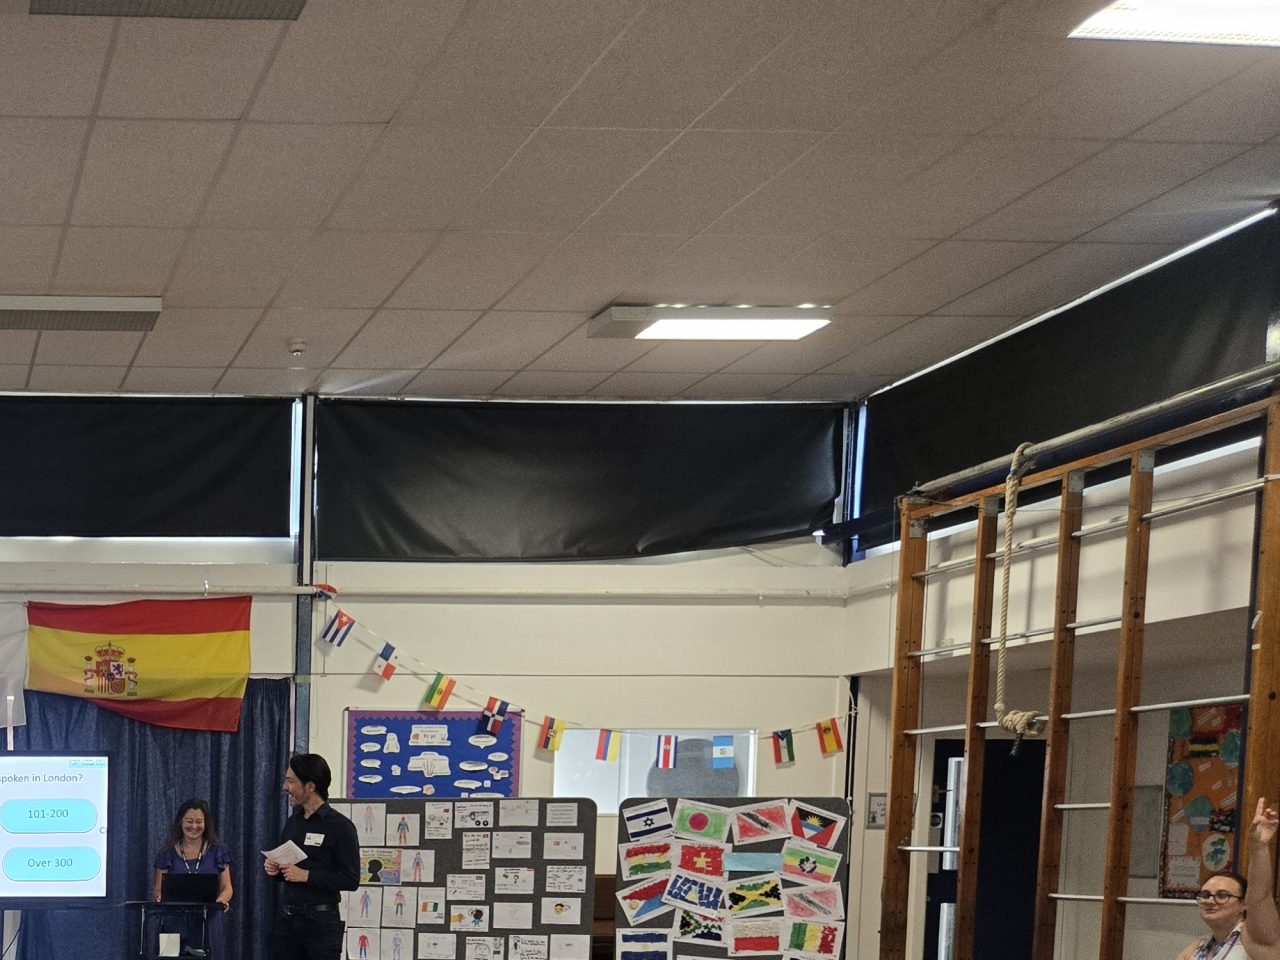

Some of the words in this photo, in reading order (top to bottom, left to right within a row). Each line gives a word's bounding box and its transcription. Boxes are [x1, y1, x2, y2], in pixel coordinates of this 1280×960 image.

[32, 773, 41, 783] in
[43, 773, 83, 783] London?
[27, 809, 69, 819] 101-200
[27, 858, 51, 867] Over
[54, 858, 73, 867] 300
